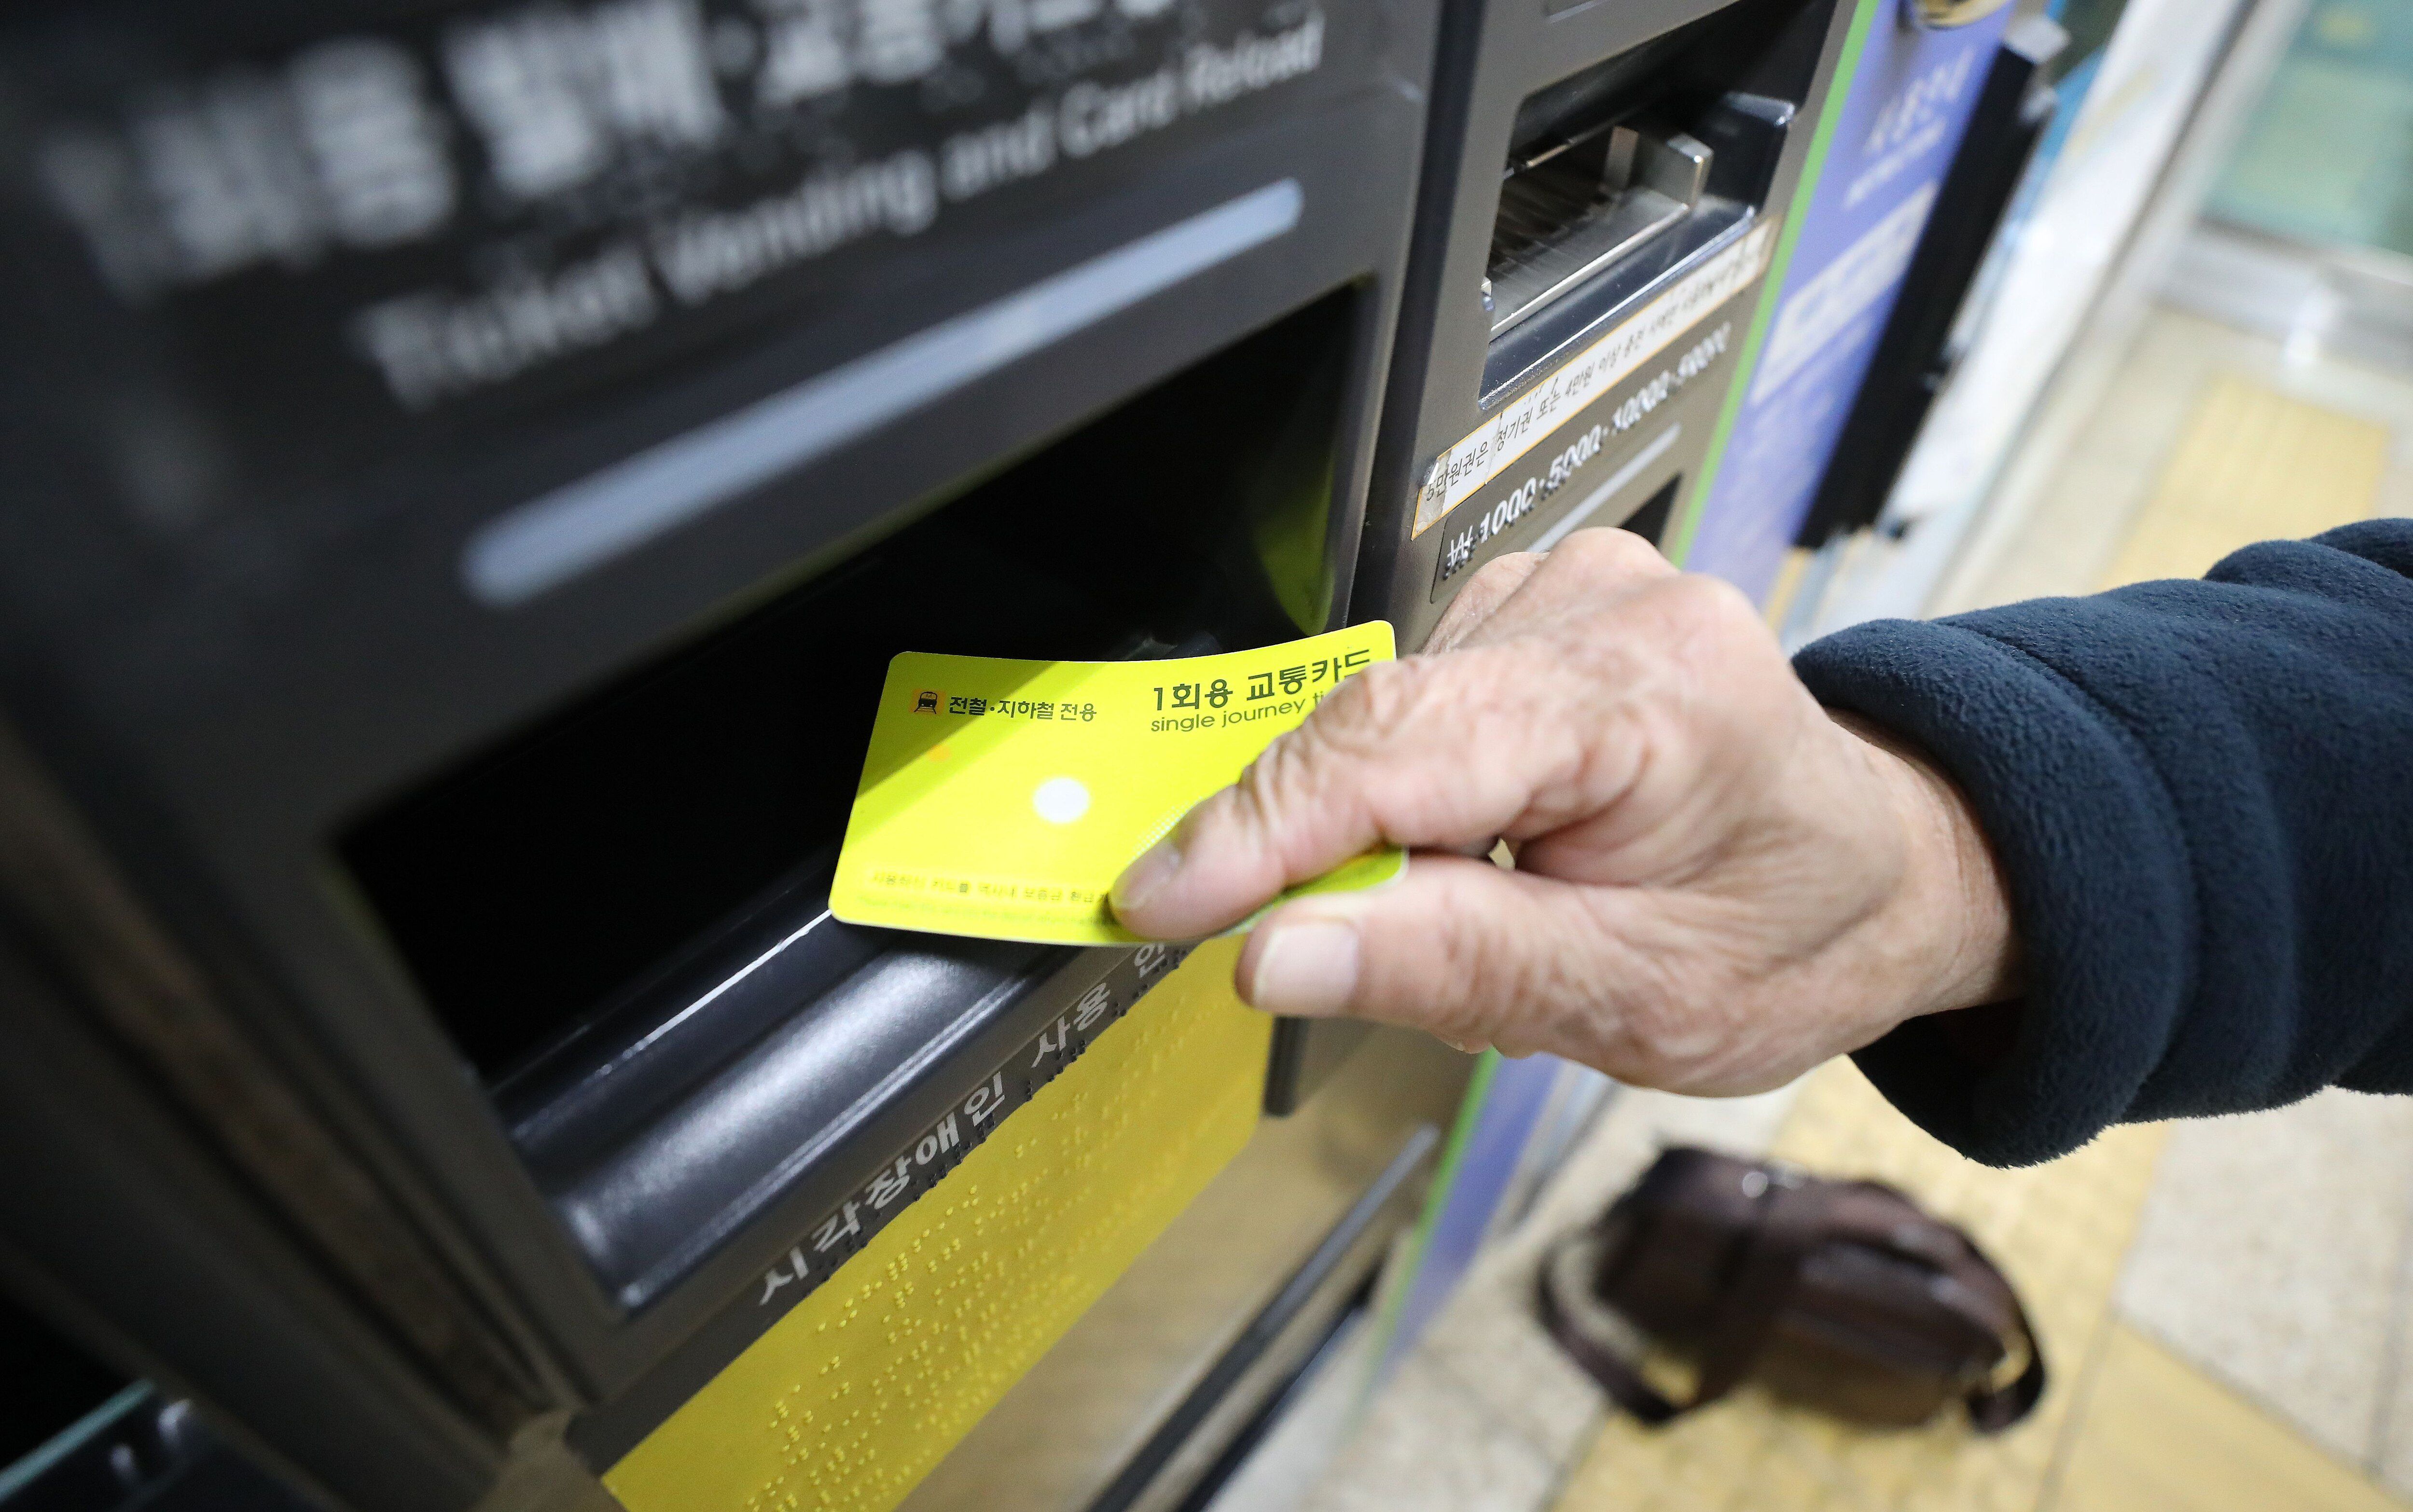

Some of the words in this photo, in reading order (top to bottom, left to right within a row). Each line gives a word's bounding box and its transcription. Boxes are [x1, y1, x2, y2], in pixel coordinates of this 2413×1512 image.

[1426, 440, 1489, 501] 5만원권은
[1497, 407, 1534, 451] 정기권
[1536, 392, 1561, 420] 또는
[949, 696, 1054, 720] 전철·지하철
[1060, 702, 1097, 722] 전용
[1153, 678, 1234, 711] 1회용
[1246, 648, 1371, 701] 교통카드
[1150, 714, 1215, 732] single
[1221, 697, 1306, 728] journey
[759, 1071, 1005, 1306] 시각장애인
[1031, 982, 1110, 1068] 사용
